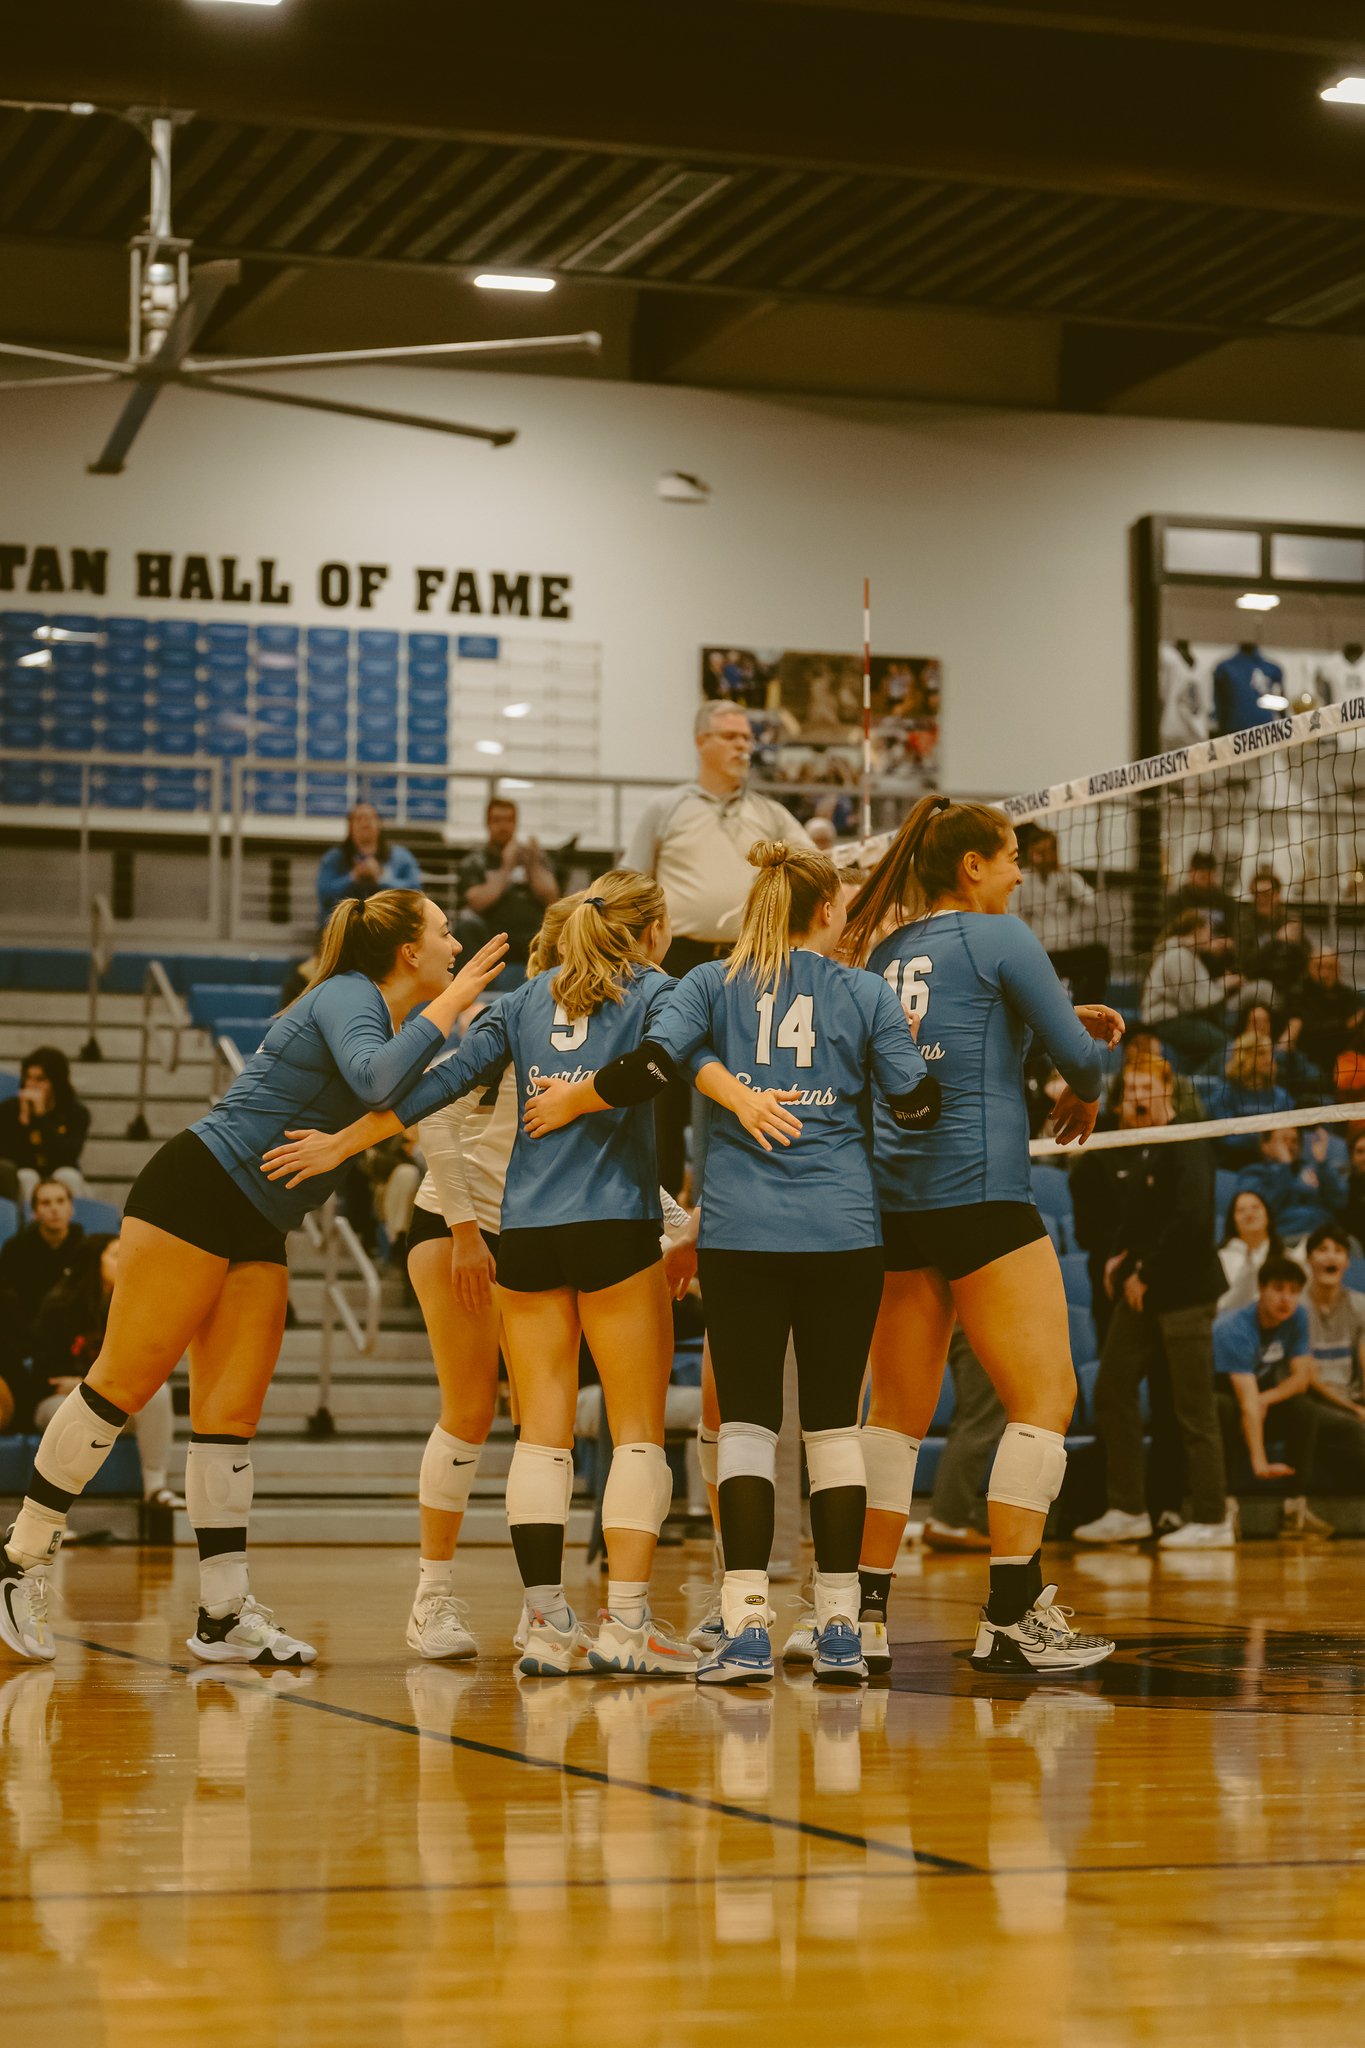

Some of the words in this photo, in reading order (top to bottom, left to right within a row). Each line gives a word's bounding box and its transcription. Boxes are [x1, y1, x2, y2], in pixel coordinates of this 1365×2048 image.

[136, 553, 289, 603] HALL
[319, 563, 388, 608] OF
[416, 569, 570, 619] FAME
[1233, 718, 1293, 755] SPARTANS
[755, 988, 817, 1069] 14
